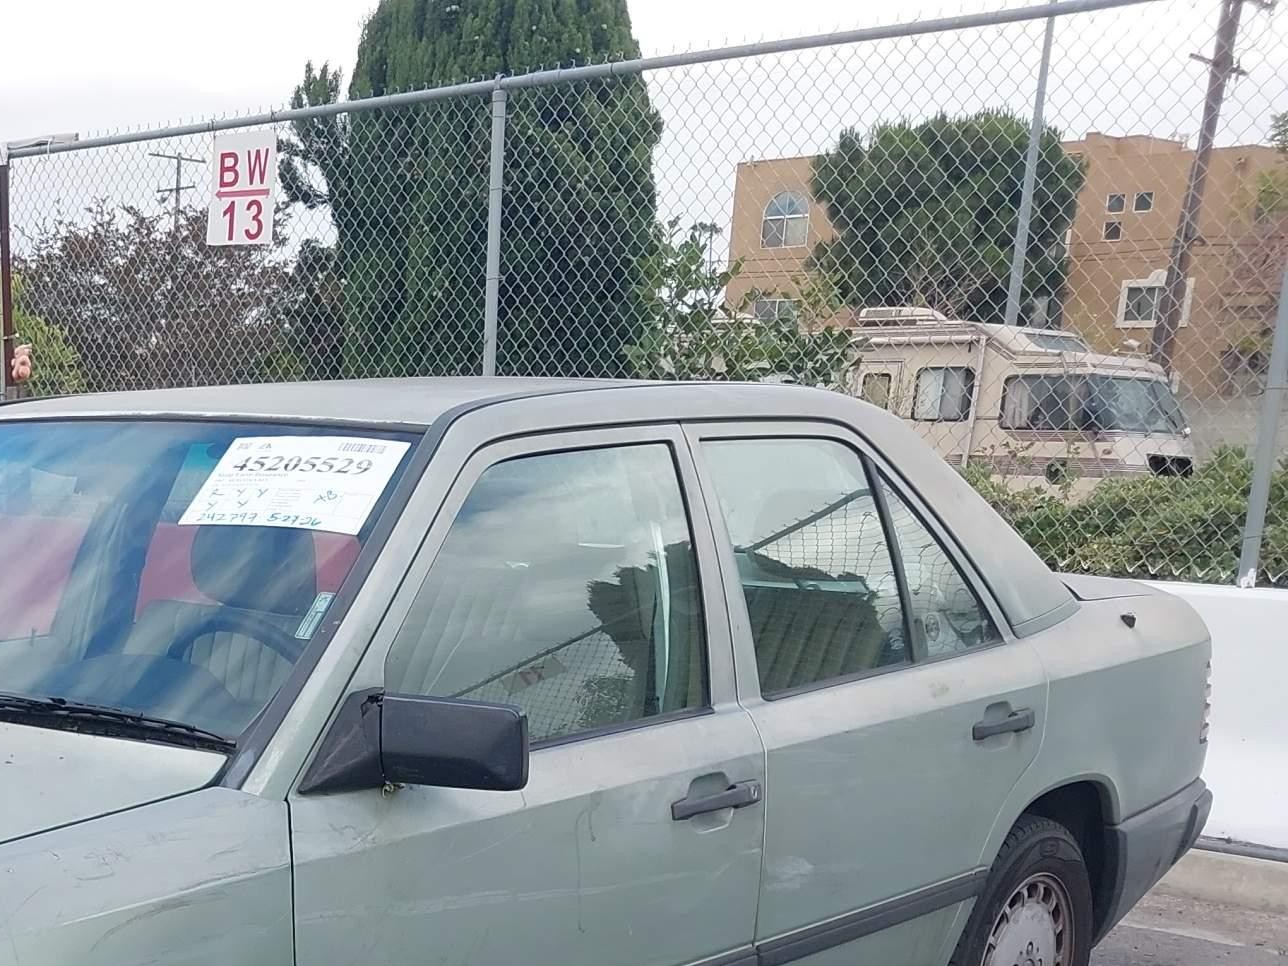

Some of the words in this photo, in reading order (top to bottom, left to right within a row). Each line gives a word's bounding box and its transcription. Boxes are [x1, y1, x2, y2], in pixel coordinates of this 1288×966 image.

[218, 147, 270, 189] BW
[222, 199, 264, 241] 13
[233, 455, 374, 475] 45205529
